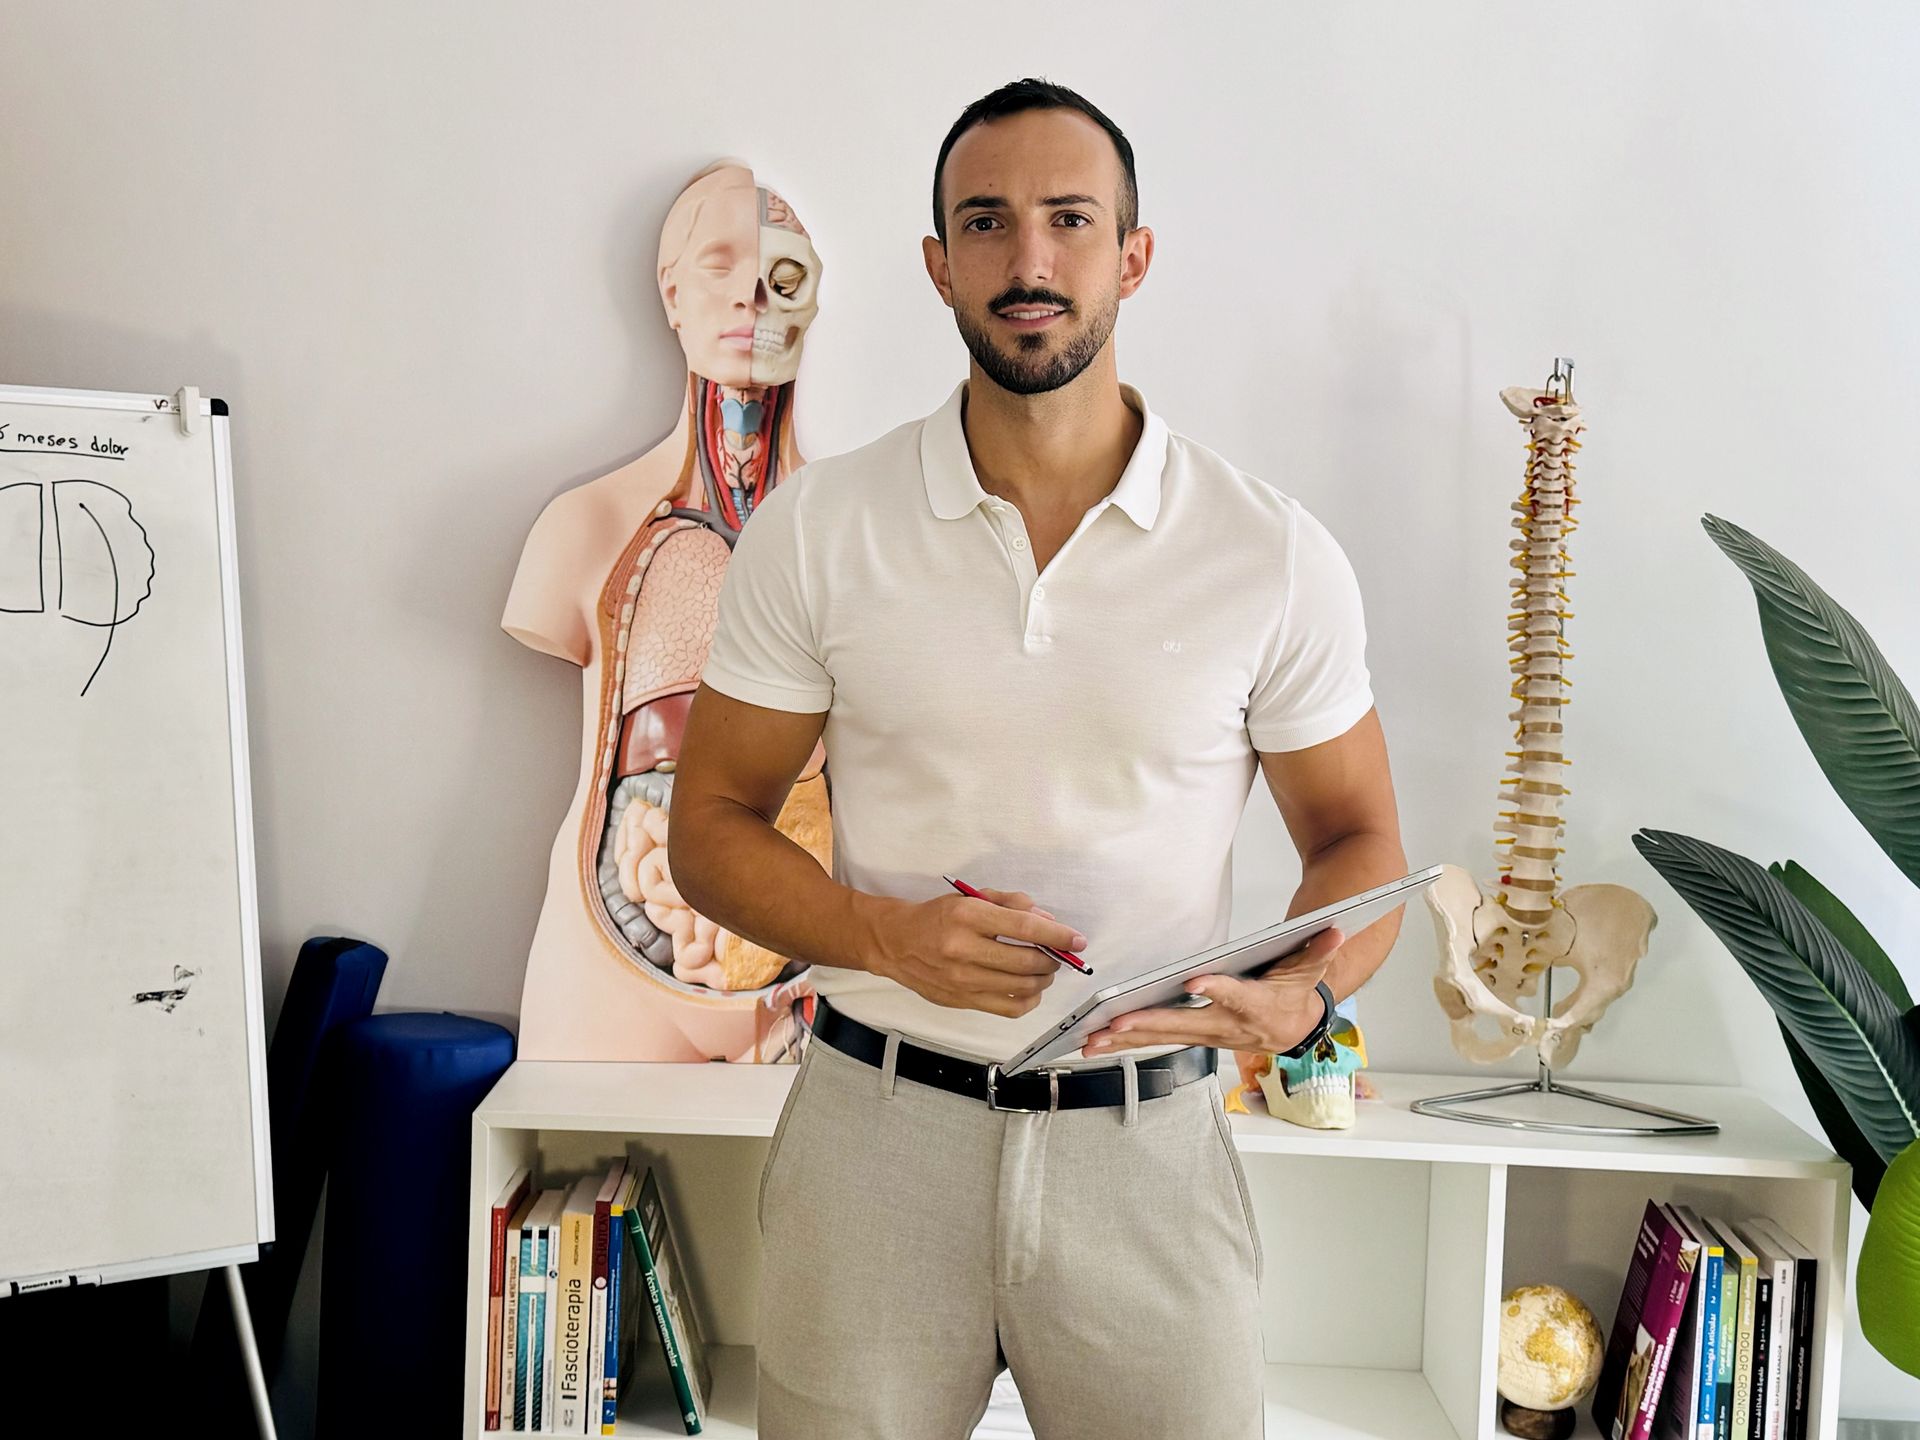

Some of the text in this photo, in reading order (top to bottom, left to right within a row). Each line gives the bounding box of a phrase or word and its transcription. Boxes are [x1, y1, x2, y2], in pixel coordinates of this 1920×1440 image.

[17, 433, 79, 449] meses
[90, 435, 129, 455] dolor
[561, 1278, 581, 1393] Fascioterapia
[645, 1269, 678, 1368] Técnica neuromuscular
[1708, 1313, 1717, 1345] Articular
[1640, 1344, 1665, 1412] Manipulaciones
[1705, 1344, 1717, 1387] Fisiología
[1736, 1332, 1750, 1426] DOLOR CRÓNICO
